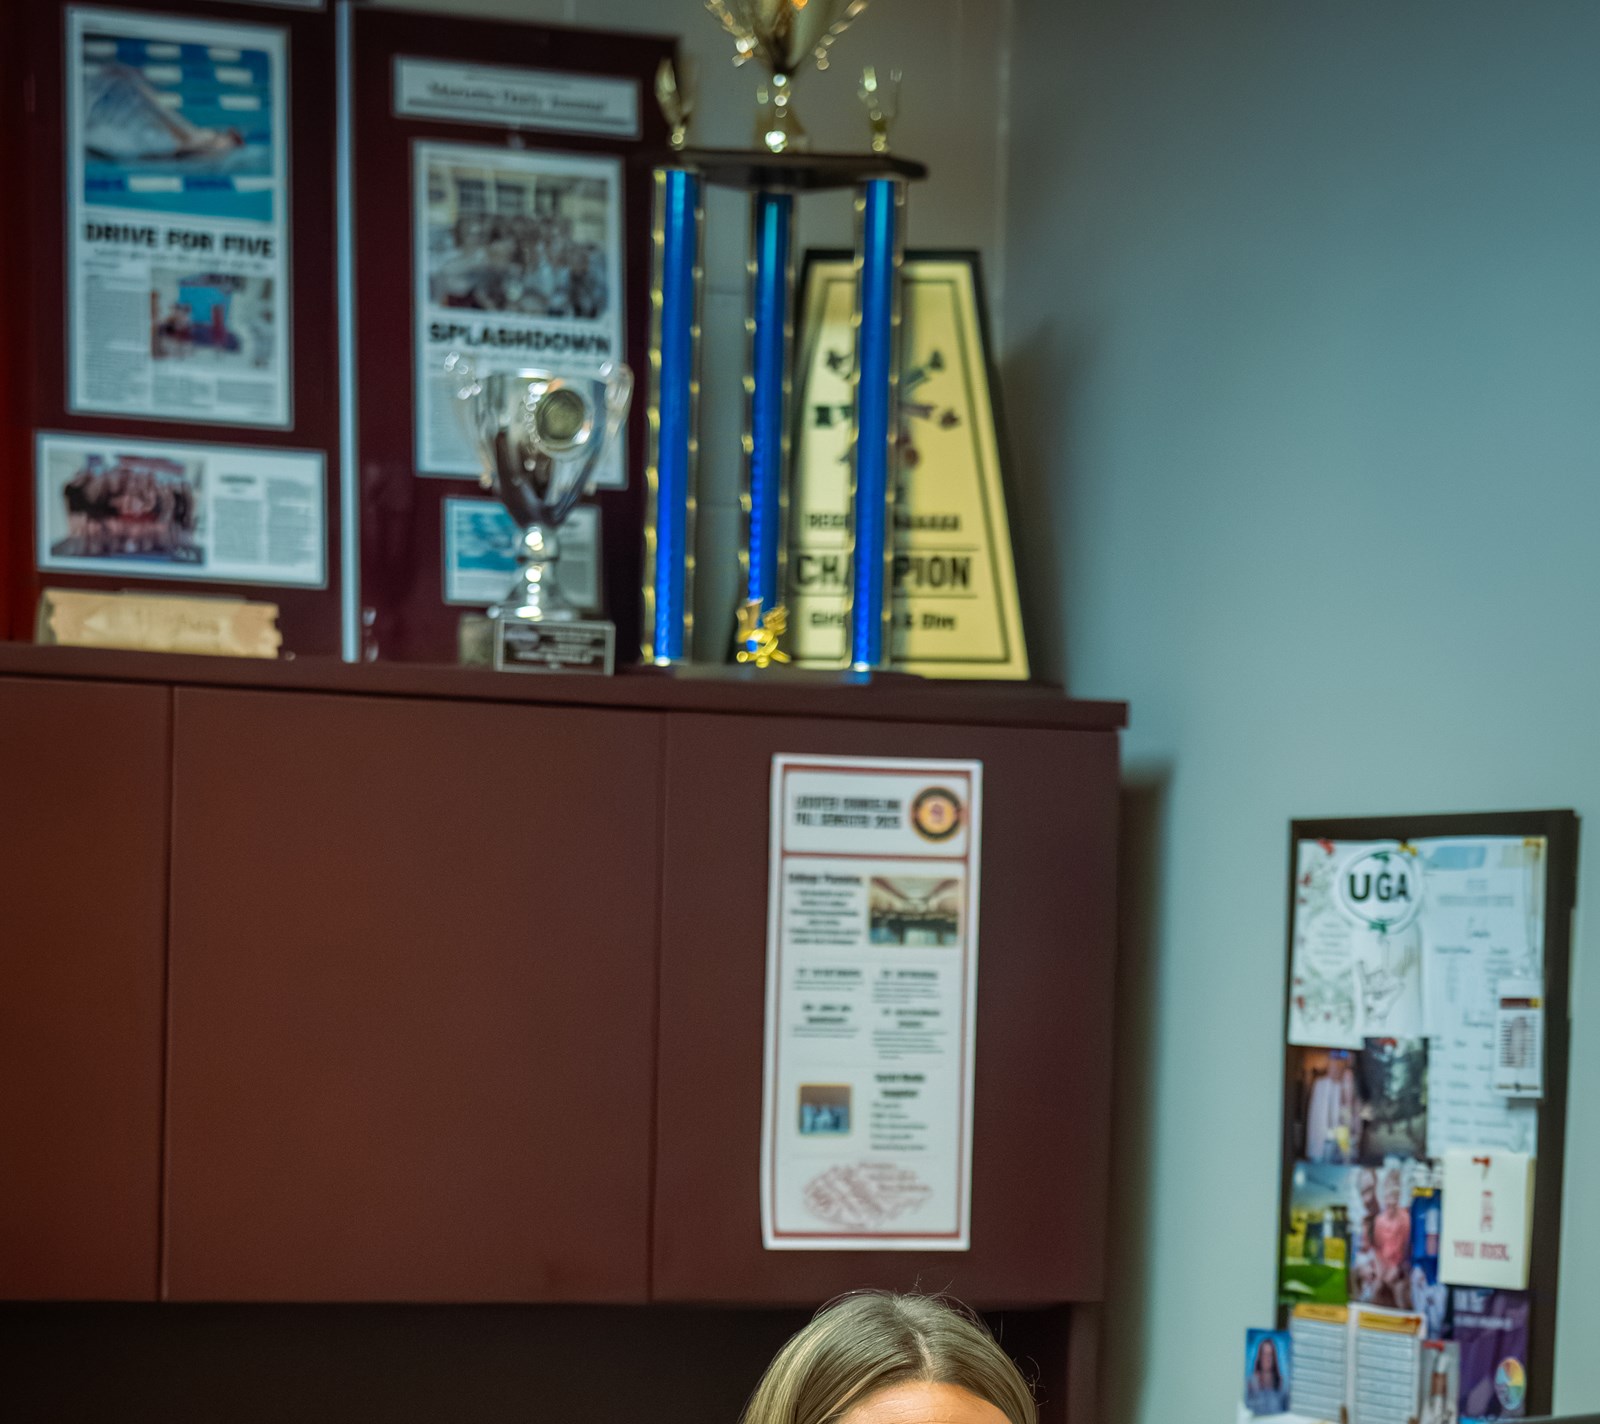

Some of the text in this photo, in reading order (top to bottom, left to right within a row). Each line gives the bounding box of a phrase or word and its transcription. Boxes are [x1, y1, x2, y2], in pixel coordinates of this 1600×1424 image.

[87, 224, 274, 258] DRIVE FOR FIVE
[430, 323, 610, 353] SPLASHDOWN
[797, 554, 971, 589] CHPION
[1349, 872, 1412, 902] UGA
